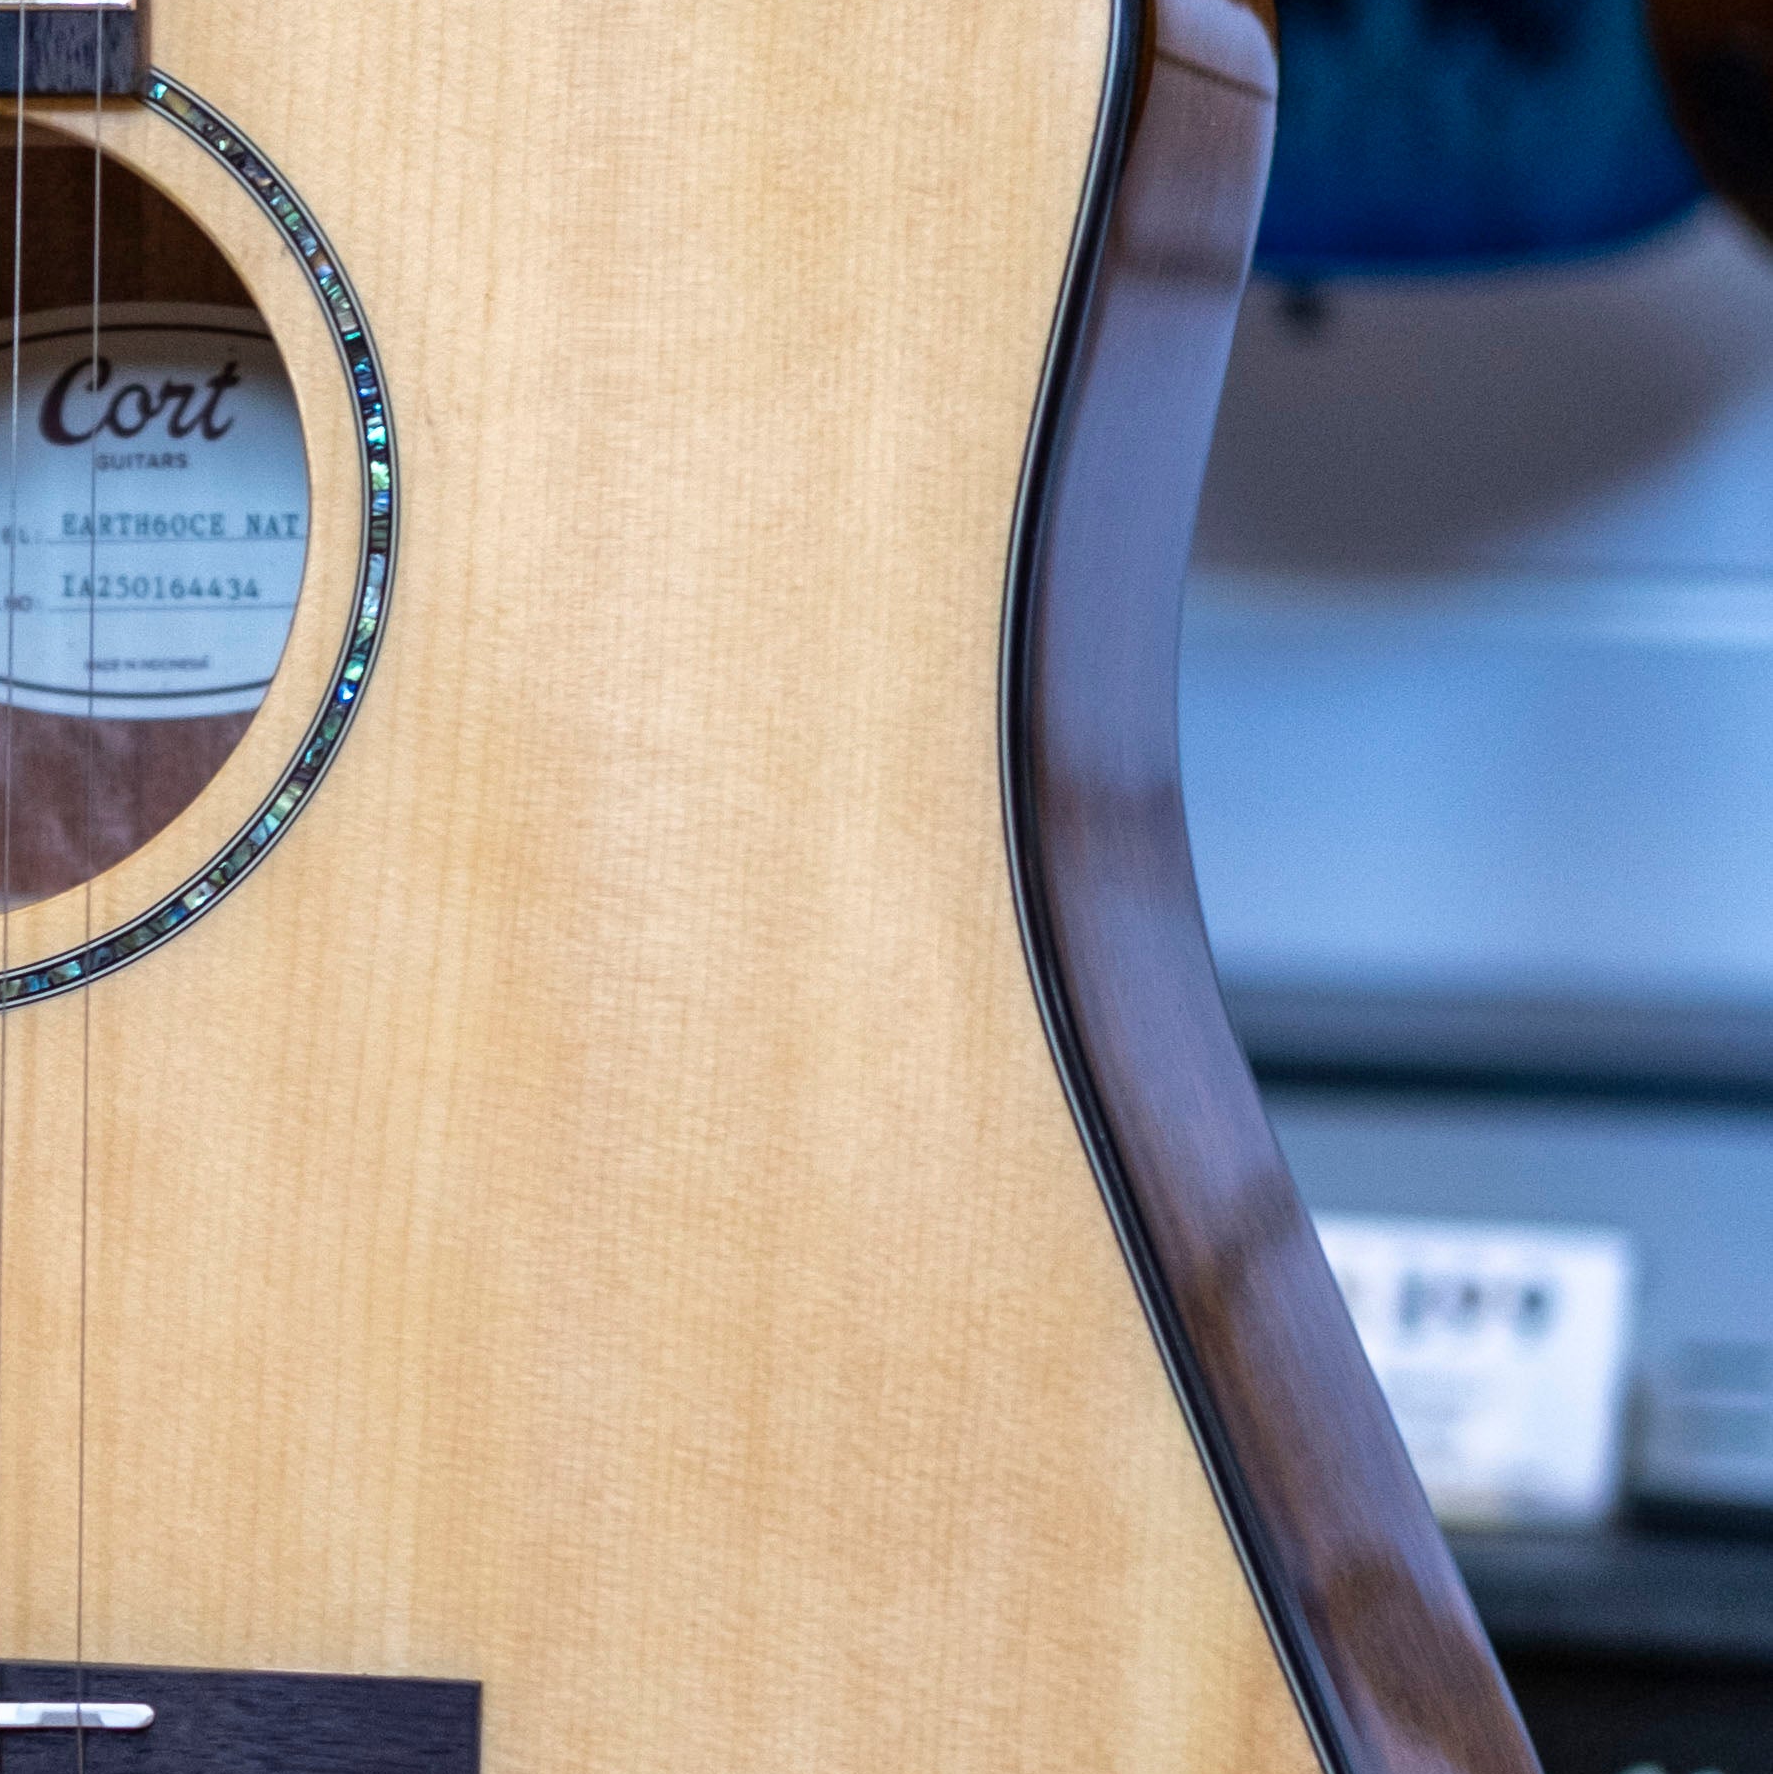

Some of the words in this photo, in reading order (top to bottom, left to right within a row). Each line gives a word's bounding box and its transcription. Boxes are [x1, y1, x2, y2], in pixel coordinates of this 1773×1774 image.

[39, 356, 241, 446] Cort
[95, 451, 188, 471] GUITARS
[245, 512, 300, 537] NAT
